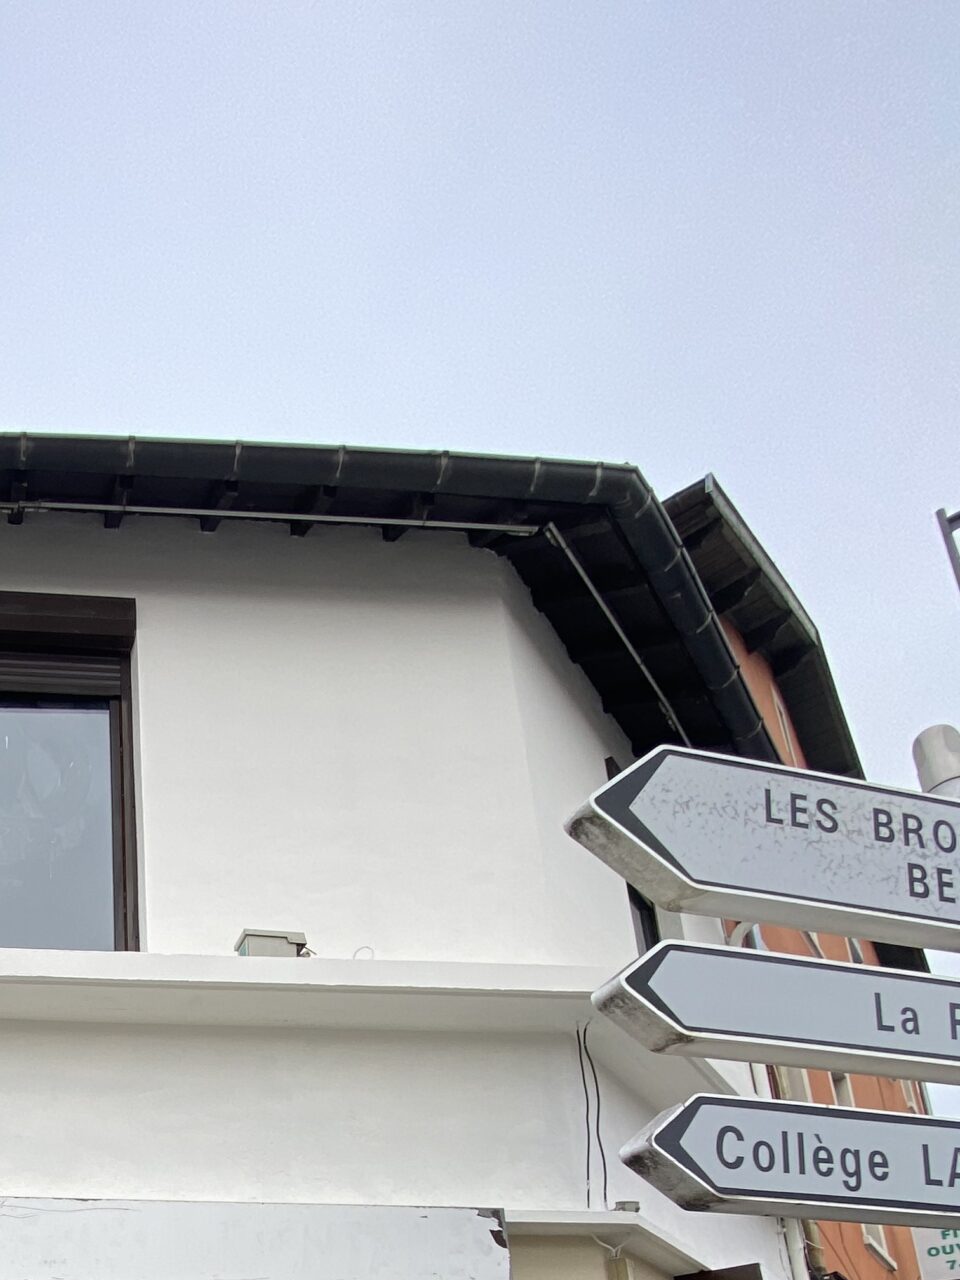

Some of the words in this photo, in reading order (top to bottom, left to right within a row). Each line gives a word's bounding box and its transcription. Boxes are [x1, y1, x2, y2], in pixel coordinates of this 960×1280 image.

[765, 789, 838, 833] LES
[873, 807, 957, 853] BRO
[907, 862, 956, 904] BE
[874, 992, 920, 1035] La
[716, 1125, 889, 1192] Collège
